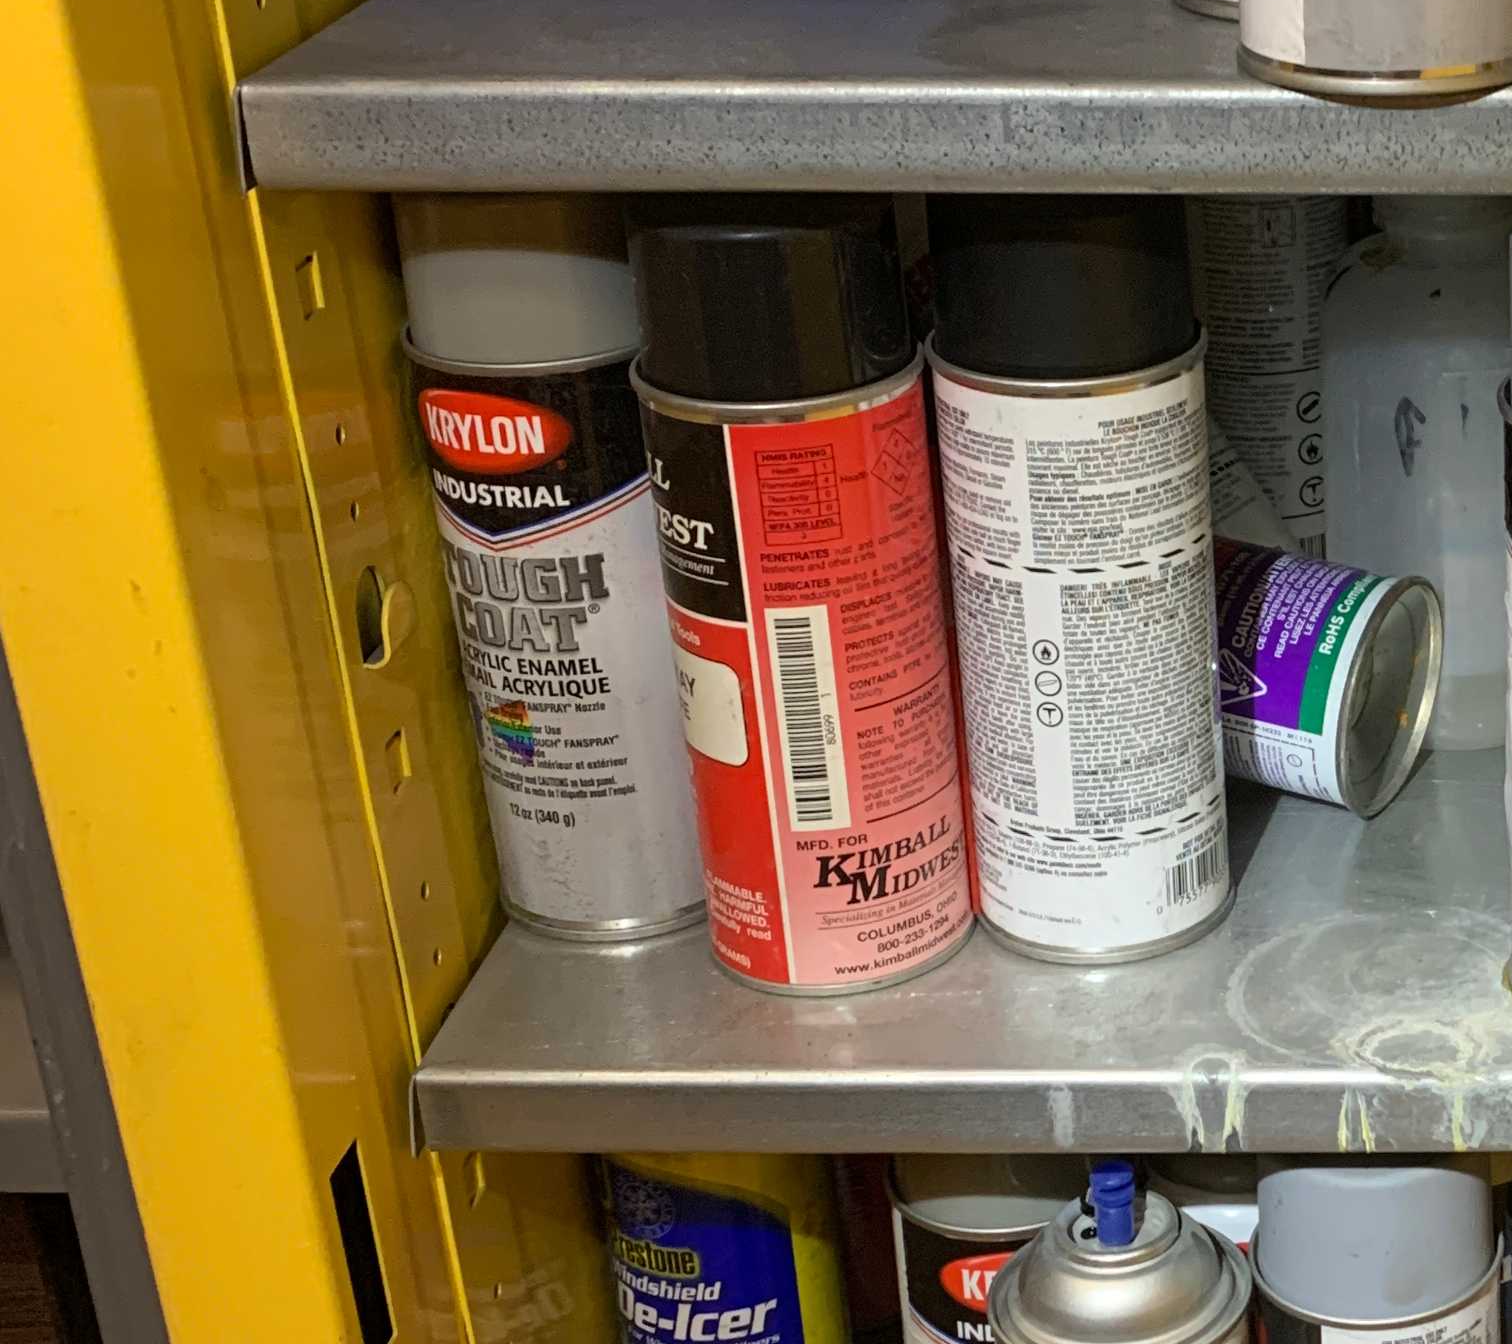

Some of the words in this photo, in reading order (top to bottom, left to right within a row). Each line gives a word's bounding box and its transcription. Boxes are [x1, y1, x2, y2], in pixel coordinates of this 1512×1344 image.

[425, 403, 545, 455] KRYLON
[433, 468, 570, 508] INDUSTRIAL
[760, 548, 829, 563] PENETRATES
[764, 578, 830, 592] LUBRICATES
[840, 592, 893, 613] DISPLACES
[455, 592, 588, 654] COAT
[1318, 615, 1344, 655] RoHS
[844, 633, 894, 652] PROTECTS
[518, 657, 603, 677] ENAMEL
[849, 670, 898, 689] CONTAINS
[502, 675, 611, 699] ACRYLIQUE
[857, 725, 884, 739] NOTE
[796, 838, 834, 852] MFD.
[838, 833, 868, 850] FOR
[813, 814, 951, 888] KIMBALL
[857, 911, 935, 943] COLUMBUS,
[877, 914, 949, 953] 800-233-1294
[615, 1238, 697, 1276] restone
[617, 1282, 778, 1342] De-Icer
